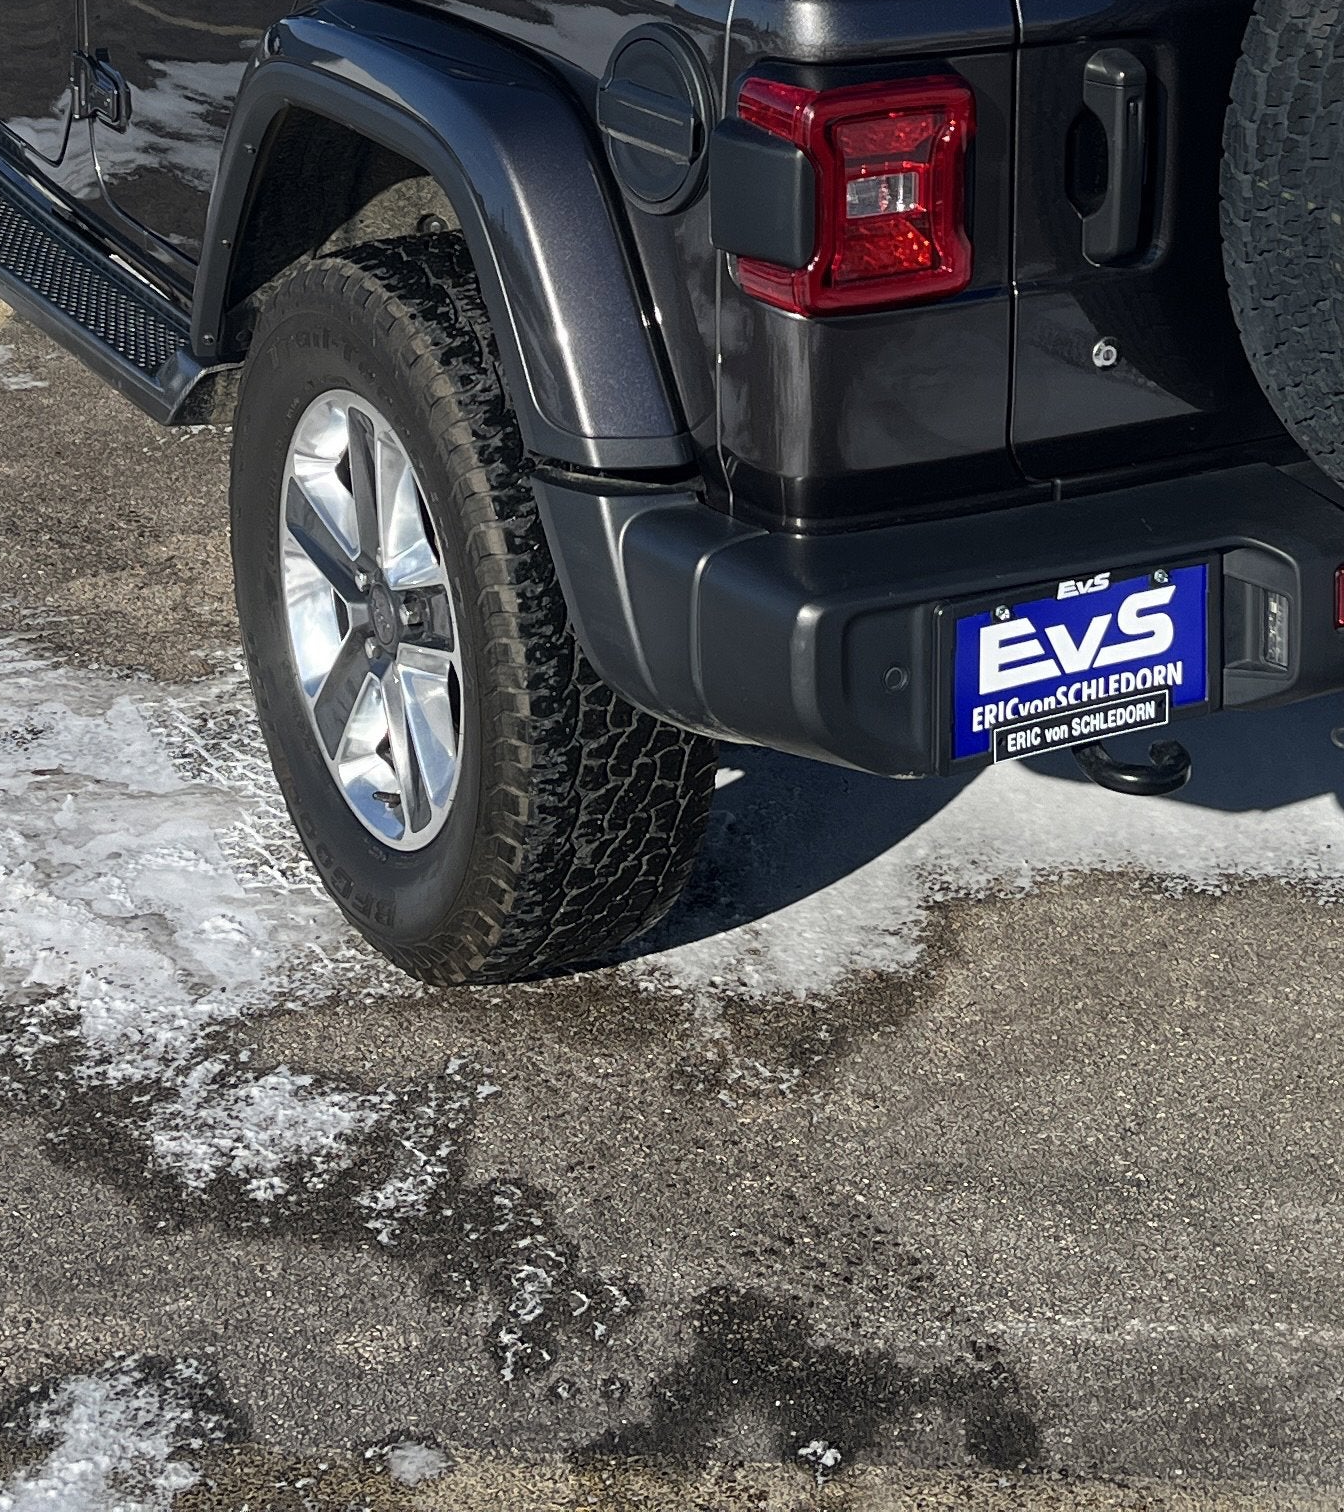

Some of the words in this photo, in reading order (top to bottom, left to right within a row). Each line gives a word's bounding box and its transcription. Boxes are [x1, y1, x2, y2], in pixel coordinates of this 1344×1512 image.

[1007, 727, 1041, 752] ERIC
[1044, 723, 1069, 743] von
[1071, 700, 1156, 736] SCHLEDORN
